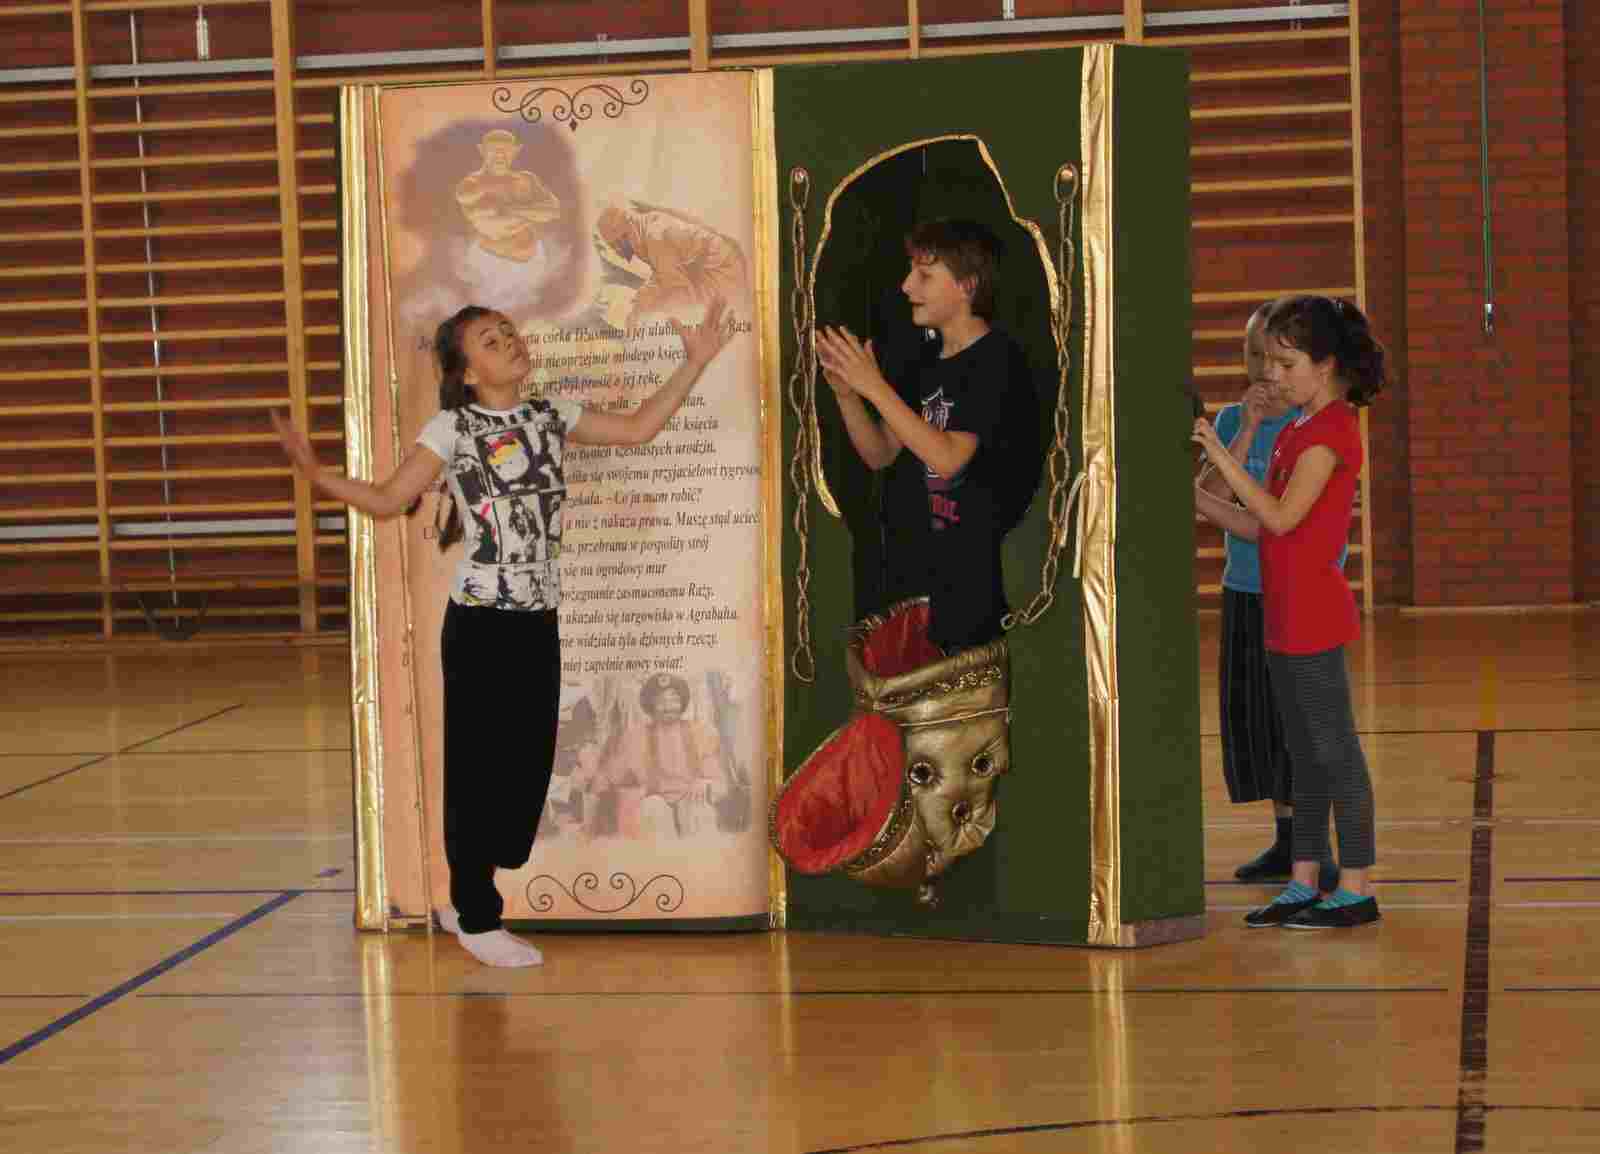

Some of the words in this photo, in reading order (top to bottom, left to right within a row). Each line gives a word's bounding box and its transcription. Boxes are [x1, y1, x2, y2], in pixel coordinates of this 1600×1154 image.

[607, 464, 648, 482] swojemu
[651, 463, 717, 484] przyjacielowi
[642, 490, 668, 503] mam
[676, 510, 709, 528] Muszę
[596, 560, 644, 580] ogrodowy
[646, 562, 667, 575] mur
[621, 607, 674, 627] targowisko
[625, 658, 651, 674] nowy
